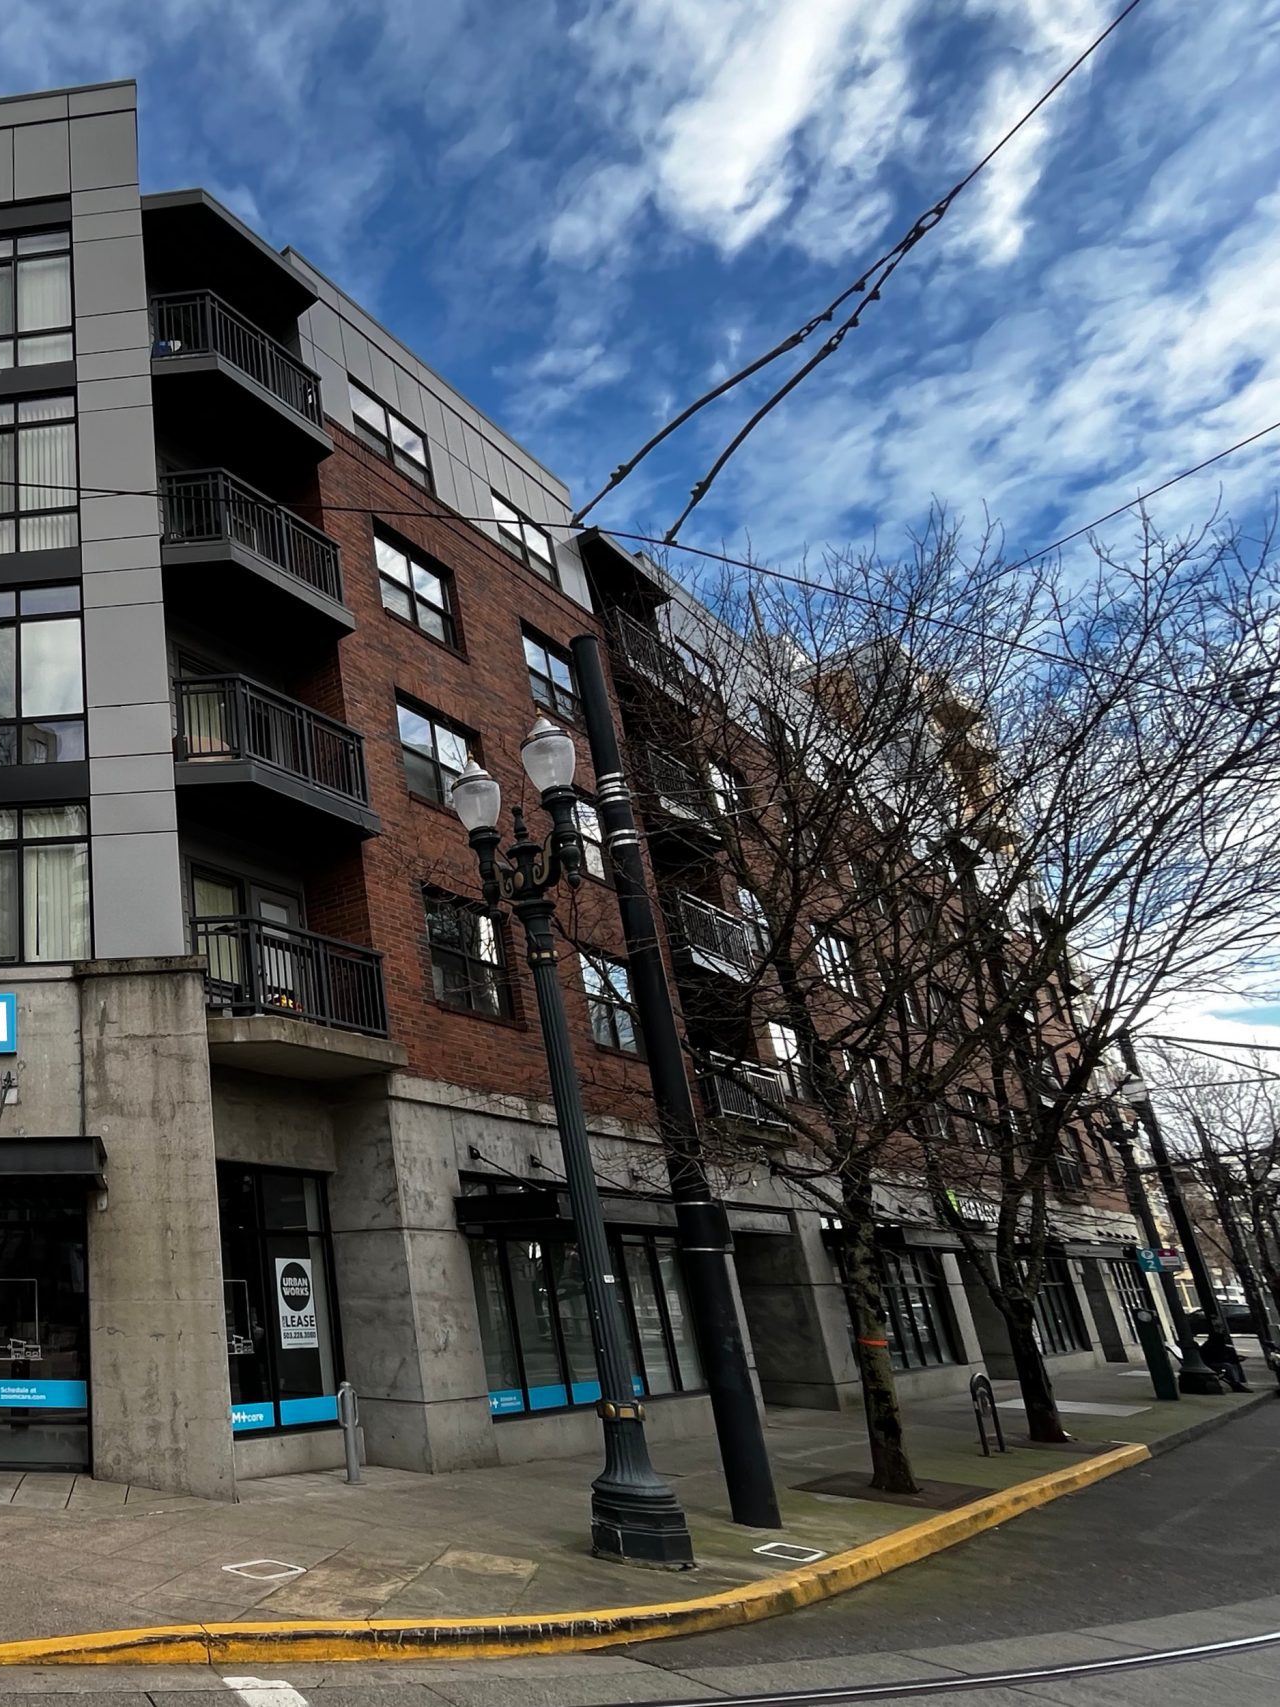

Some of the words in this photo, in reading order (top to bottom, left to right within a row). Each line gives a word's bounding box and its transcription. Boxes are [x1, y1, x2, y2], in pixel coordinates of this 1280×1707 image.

[1147, 1260, 1157, 1269] 2
[282, 1277, 308, 1287] URBAN
[282, 1287, 310, 1297] WORKS
[286, 1315, 316, 1328] LEASE
